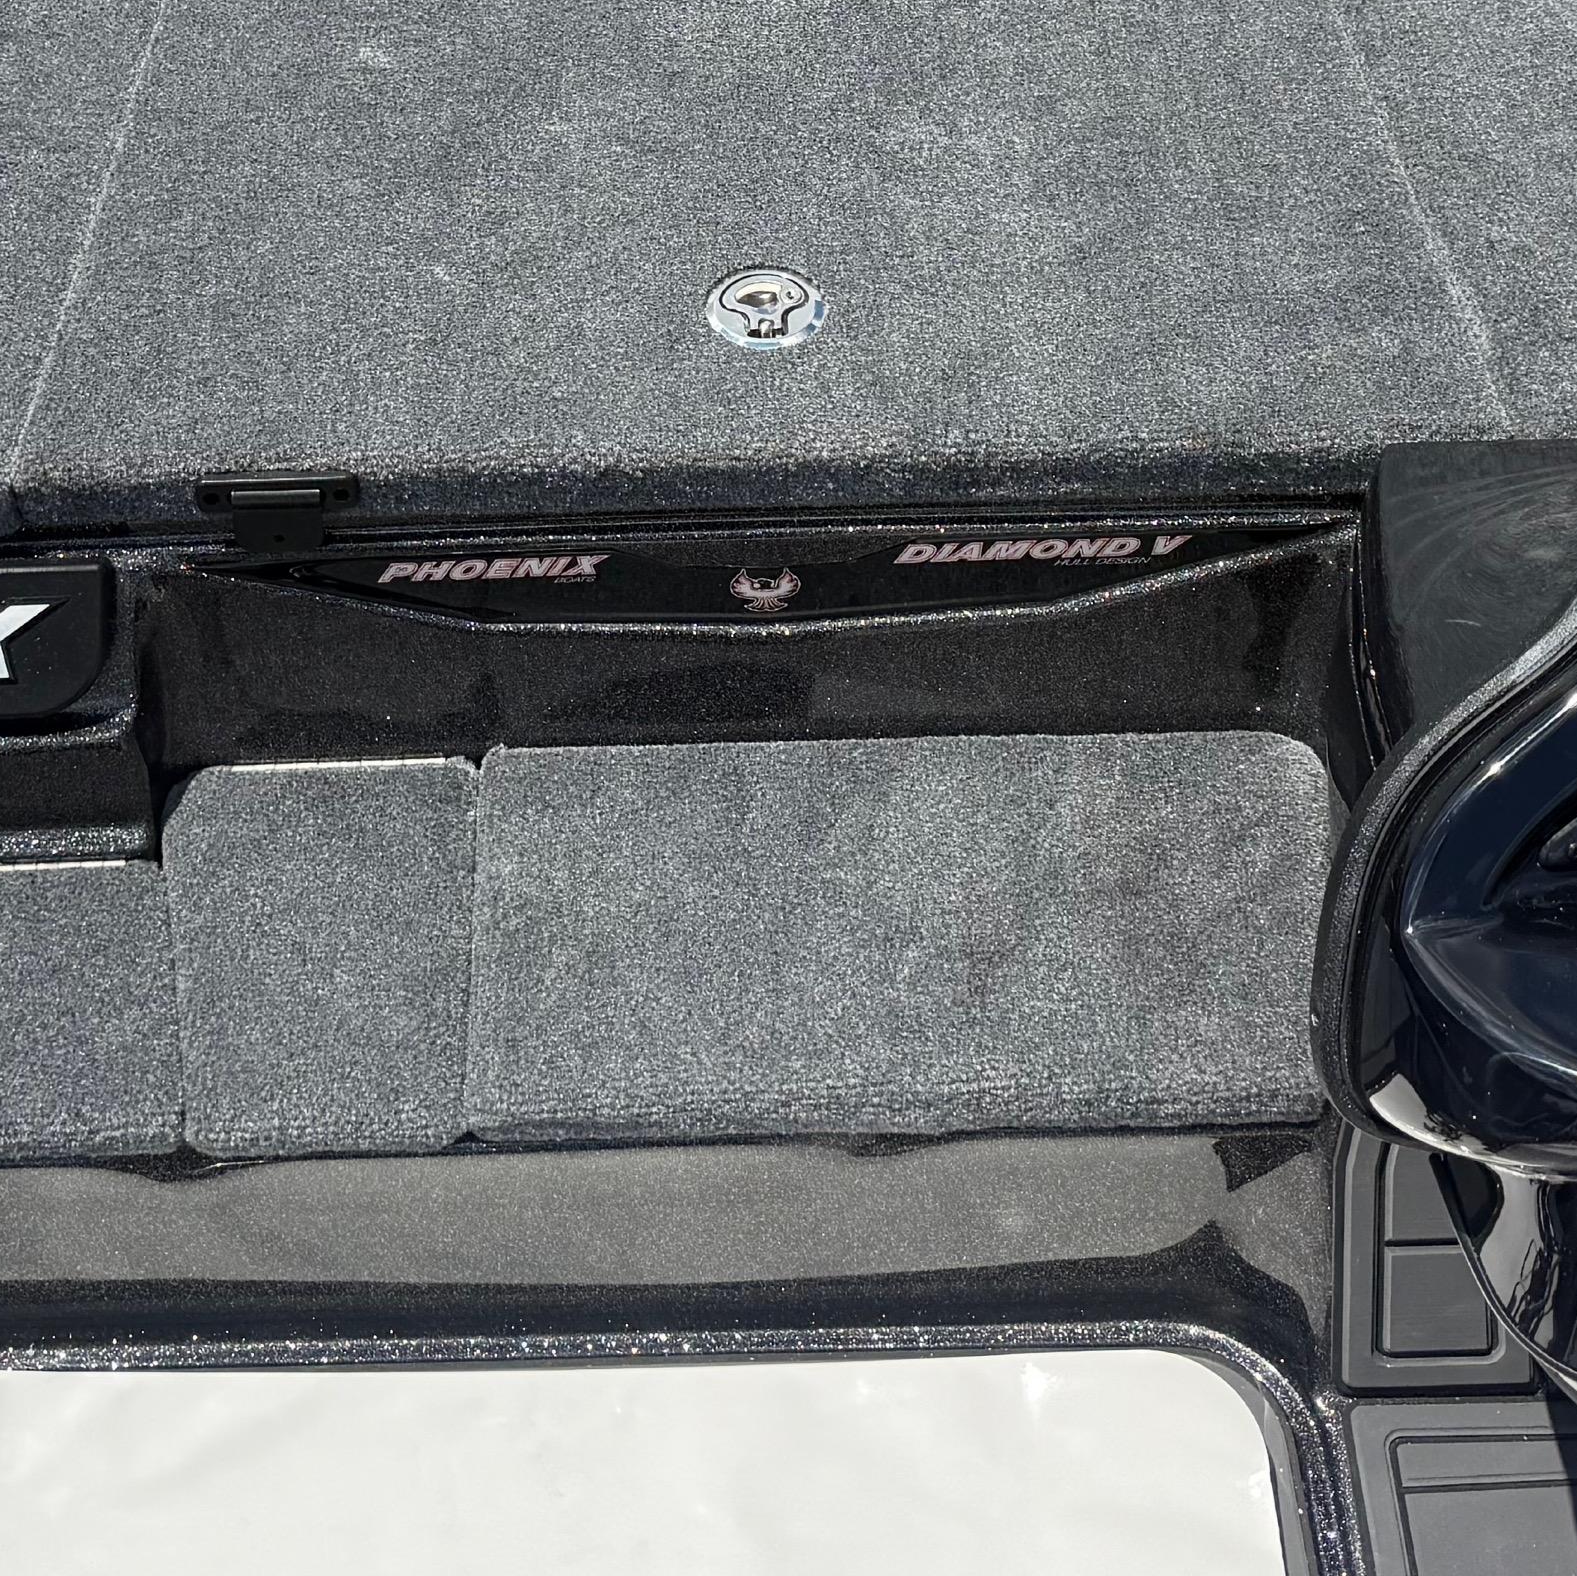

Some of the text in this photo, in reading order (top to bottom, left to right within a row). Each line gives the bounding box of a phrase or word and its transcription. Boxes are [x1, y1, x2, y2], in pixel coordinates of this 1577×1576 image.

[894, 535, 1193, 564] DIAMOND V
[1054, 555, 1152, 567] HULL DESIGN
[377, 554, 612, 584] PHOENIX
